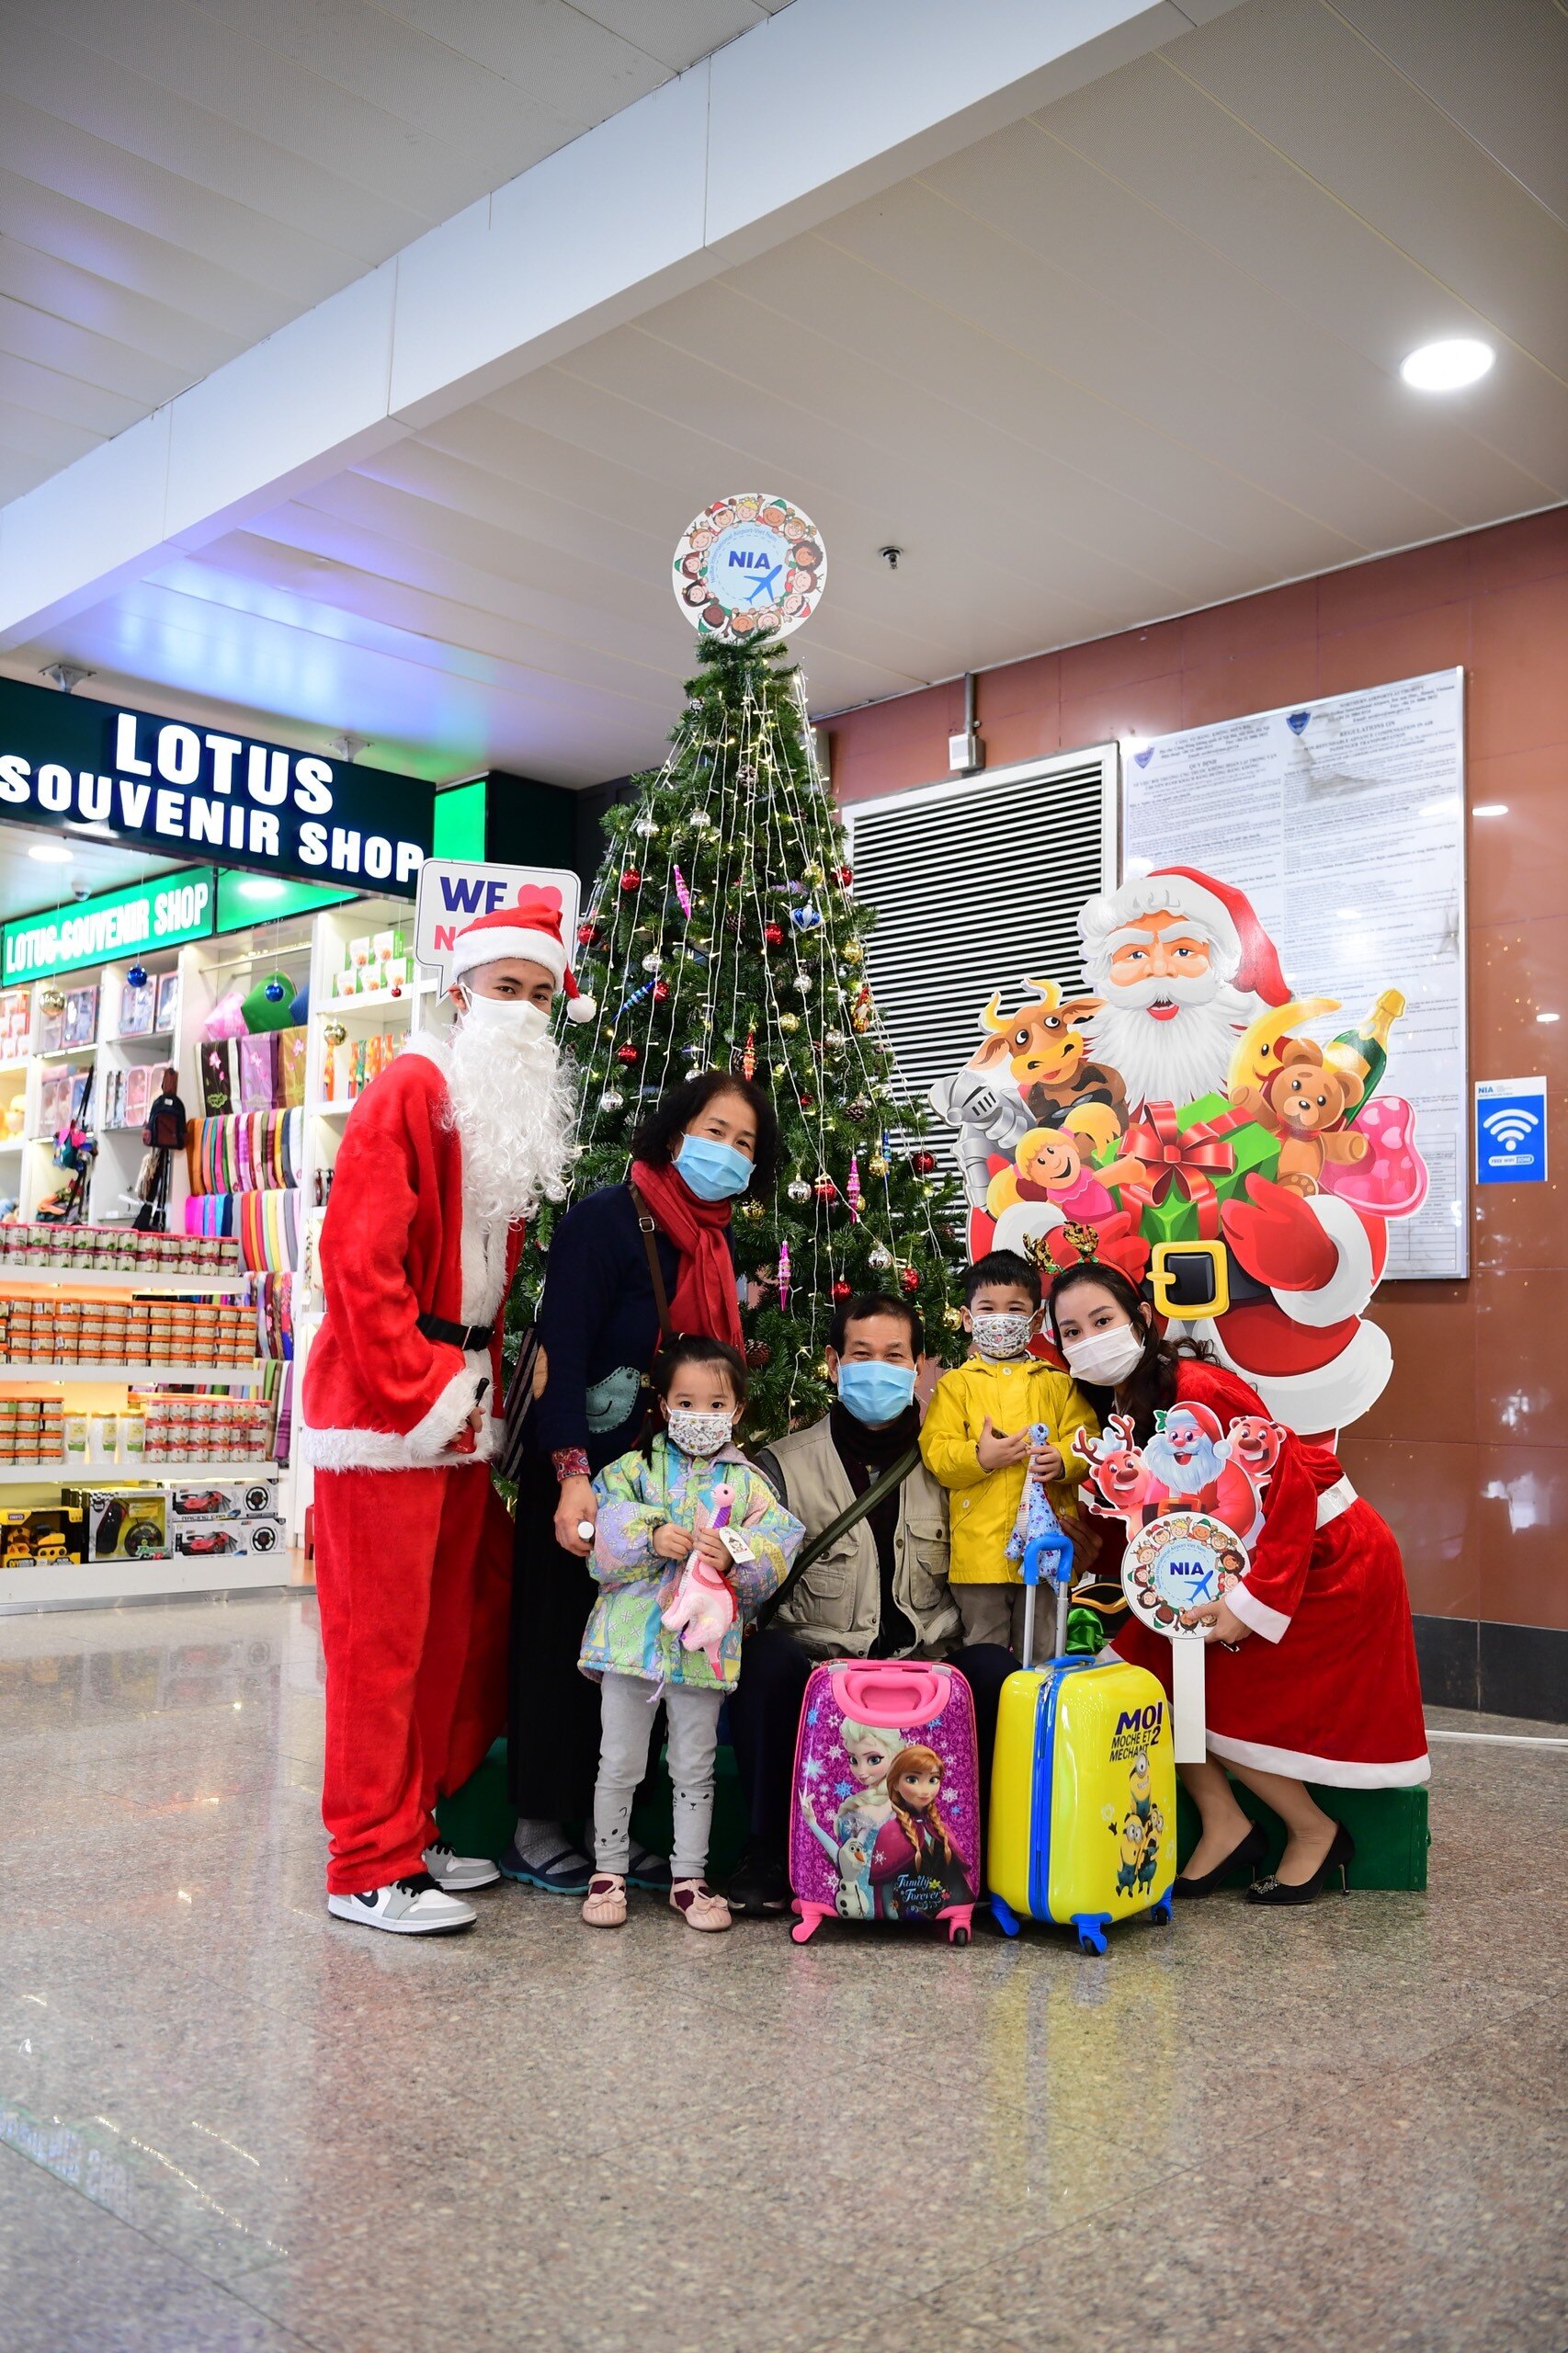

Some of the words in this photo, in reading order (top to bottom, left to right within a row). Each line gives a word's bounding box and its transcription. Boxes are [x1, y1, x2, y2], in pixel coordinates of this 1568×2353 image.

[728, 550, 771, 570] NIA
[114, 711, 335, 816] LOTUS
[0, 754, 281, 858] SOUVENIR
[298, 821, 426, 883] SHOP
[153, 881, 210, 937] SHOP
[439, 876, 508, 915] WE
[1170, 1562, 1205, 1575] NIA
[1115, 1701, 1163, 1735] MOI
[1111, 1732, 1142, 1749] MOCHE
[1142, 1729, 1152, 1744] ET
[1150, 1724, 1162, 1746] 2
[895, 1873, 932, 1890] Family
[903, 1887, 941, 1903] Forever
